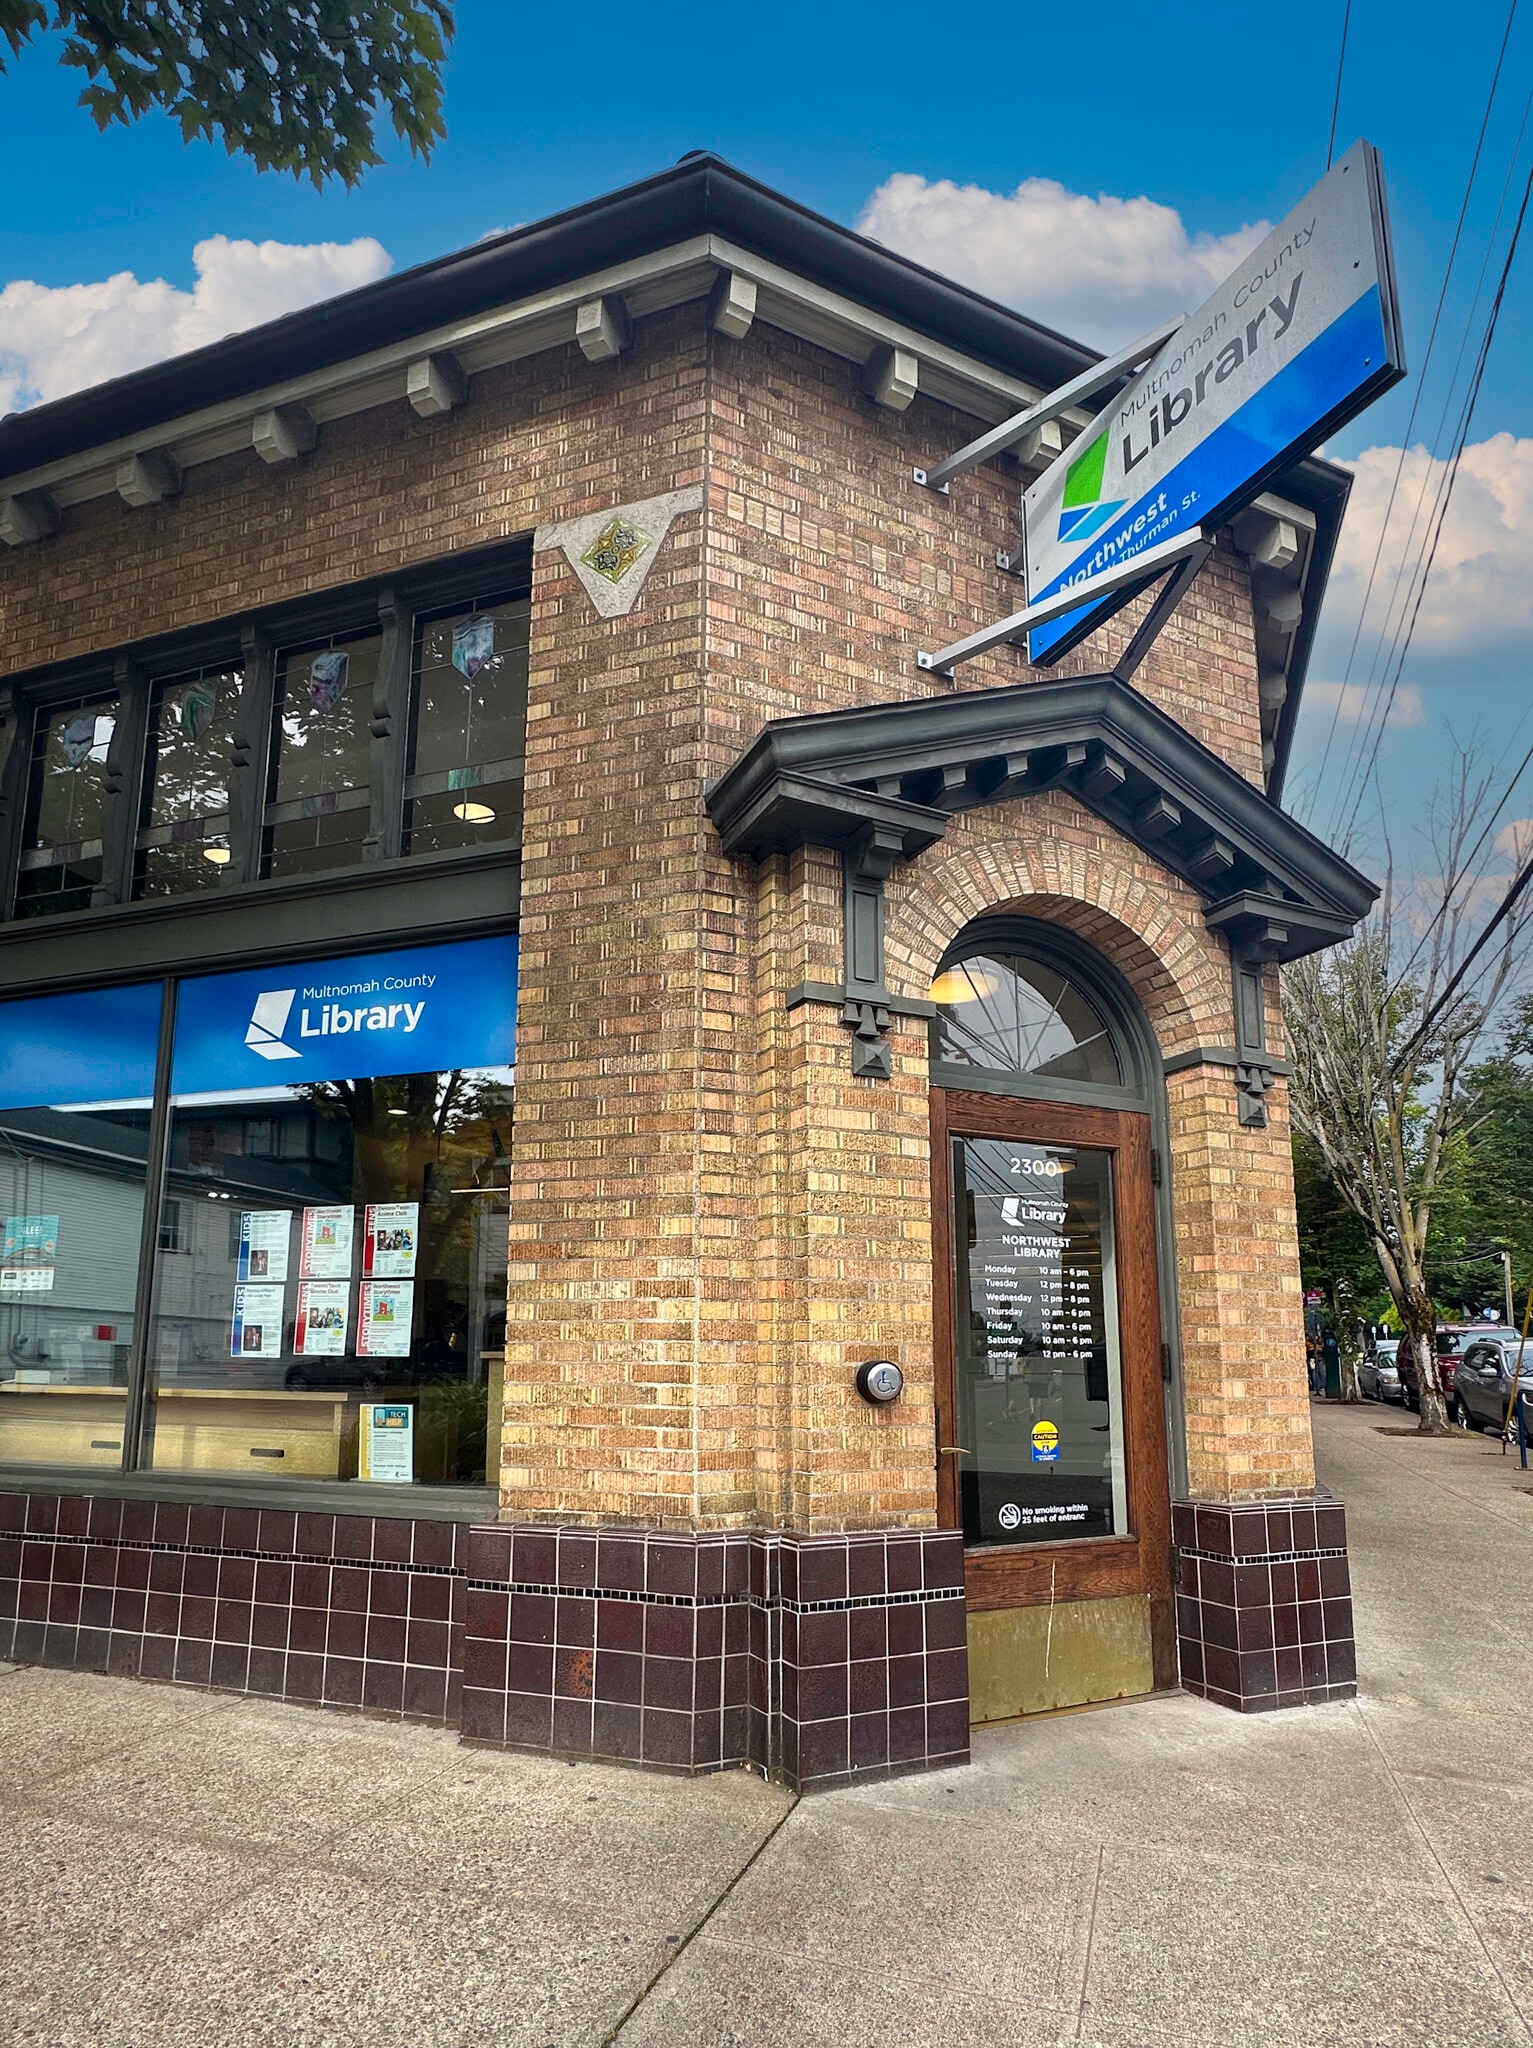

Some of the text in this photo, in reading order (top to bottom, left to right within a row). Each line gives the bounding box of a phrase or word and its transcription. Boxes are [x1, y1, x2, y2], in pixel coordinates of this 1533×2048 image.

[1120, 218, 1317, 426] Multnomah County
[1123, 271, 1304, 475] Library
[1119, 490, 1201, 565] Thurman St.
[302, 973, 437, 1000] Multnomah County
[300, 1001, 426, 1038] Library
[1010, 1158, 1058, 1177] 2300
[1050, 1201, 1069, 1209] County
[367, 1207, 376, 1237] TEENS
[1021, 1207, 1067, 1224] Library
[242, 1214, 252, 1242] KIDS
[304, 1210, 315, 1270] STORYTIMES
[1002, 1235, 1071, 1248] NORTHWEST
[1014, 1247, 1061, 1259] LIBRARY
[984, 1264, 1017, 1275] Monday
[1039, 1267, 1048, 1275] 10
[1069, 1268, 1075, 1276] 6
[1076, 1269, 1089, 1277] pm
[985, 1279, 1018, 1289] Tuesday
[1040, 1281, 1048, 1289] 12
[1050, 1282, 1062, 1290] pm
[1069, 1282, 1075, 1290] 8
[1077, 1283, 1090, 1291] pm
[236, 1288, 246, 1316] KIDS
[300, 1284, 309, 1314] TEENS
[986, 1293, 1032, 1303] Wednesday
[1050, 1296, 1063, 1304] pm
[1070, 1295, 1076, 1303] 8
[1077, 1297, 1090, 1305] pm
[361, 1285, 372, 1348] STORYTIMES
[986, 1307, 1023, 1317] Thursday
[1041, 1308, 1050, 1316] 10
[1071, 1309, 1077, 1317] 6
[1078, 1310, 1091, 1318] pm
[986, 1321, 1013, 1331] Friday
[1041, 1322, 1051, 1331] 10
[1071, 1323, 1077, 1331] 6
[1079, 1324, 1092, 1332] pm
[987, 1335, 1023, 1345] Saturday
[1042, 1336, 1051, 1344] 10
[1072, 1336, 1078, 1344] 6
[1079, 1338, 1093, 1346] pm
[987, 1350, 1018, 1359] Sunday
[1042, 1350, 1051, 1358] 12
[1052, 1351, 1066, 1359] pm
[1072, 1350, 1078, 1358] 6
[1080, 1351, 1093, 1359] pm
[1022, 1503, 1089, 1515] No smoking within
[1022, 1513, 1086, 1525] 25 feet of entranc
